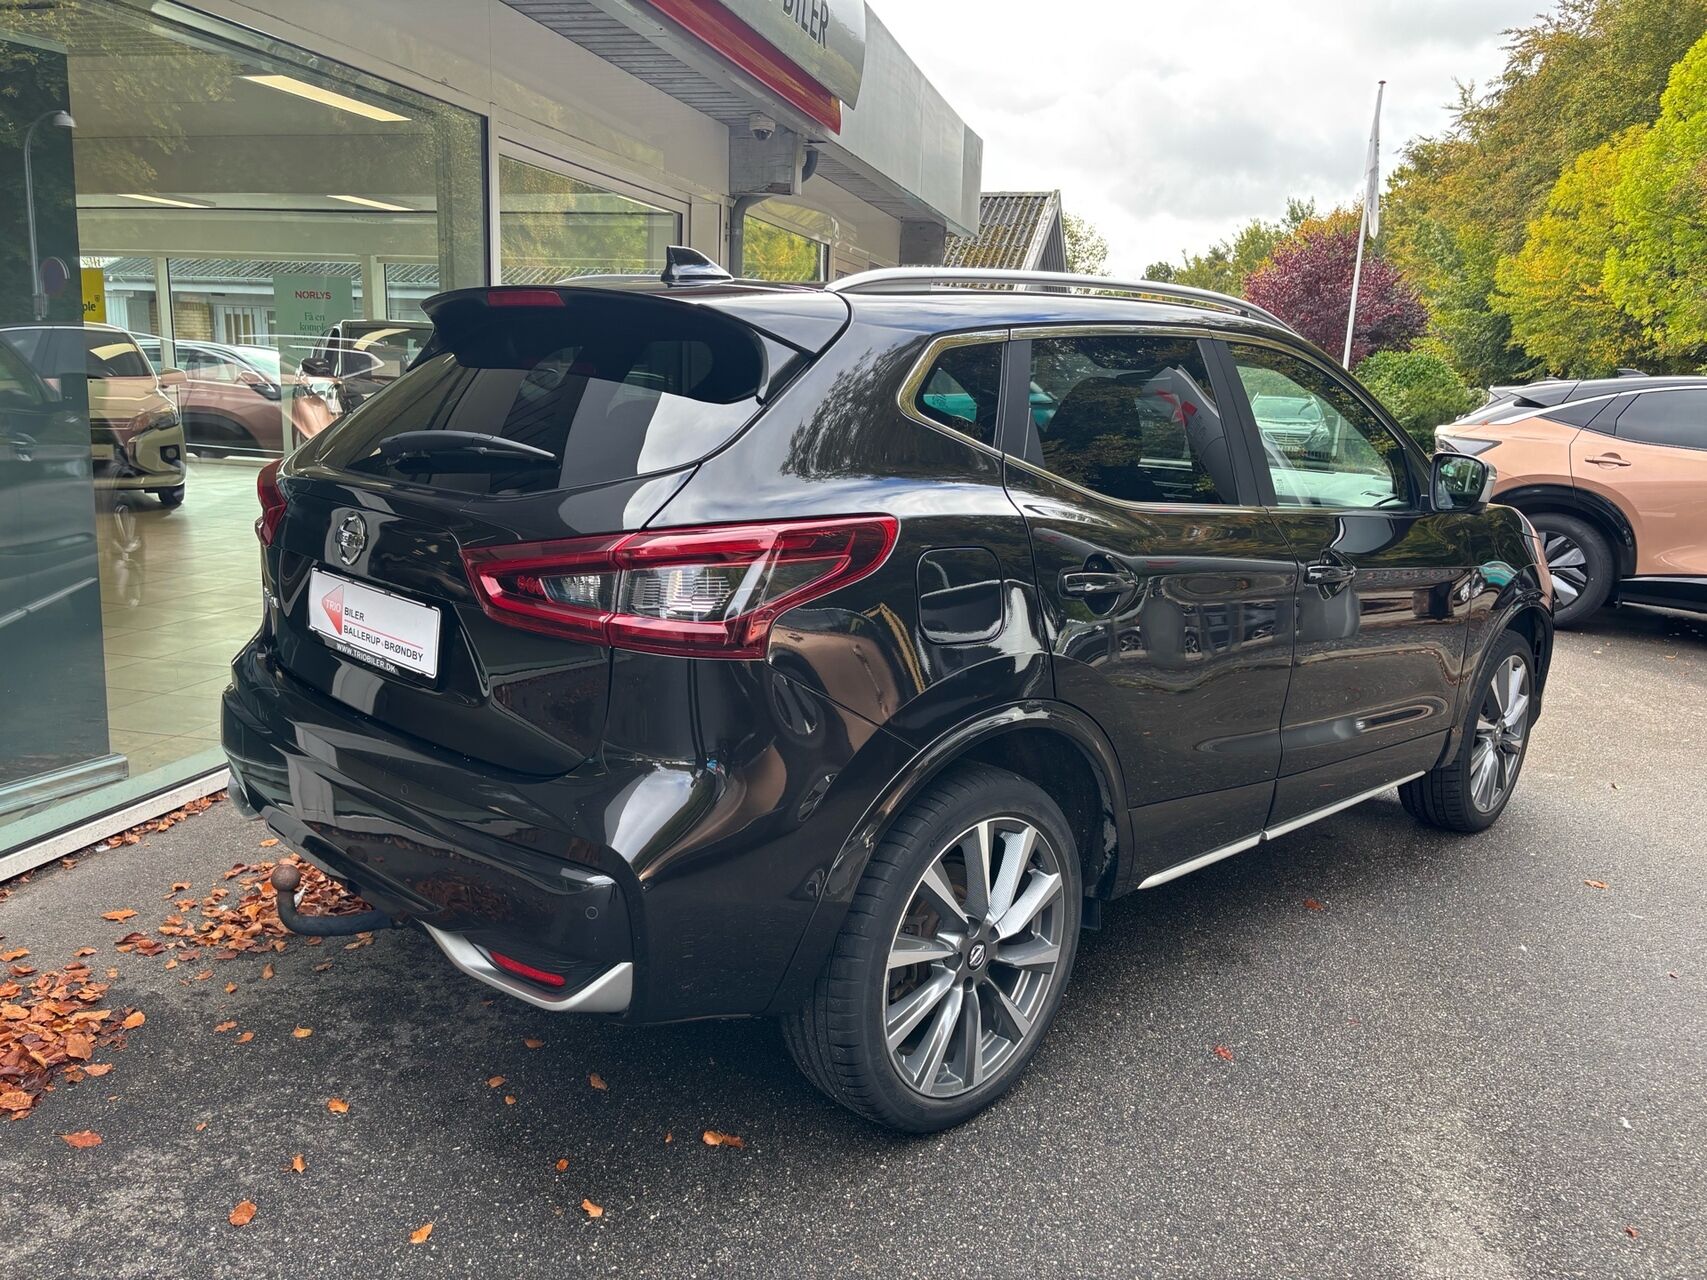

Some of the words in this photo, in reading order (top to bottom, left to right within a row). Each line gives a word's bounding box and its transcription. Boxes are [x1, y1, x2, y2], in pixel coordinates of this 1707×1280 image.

[295, 291, 332, 300] NORLYS
[326, 599, 342, 613] TRIO
[344, 606, 365, 622] BILER
[343, 624, 381, 646] BALLERUP
[384, 640, 424, 662] BRØNDBY
